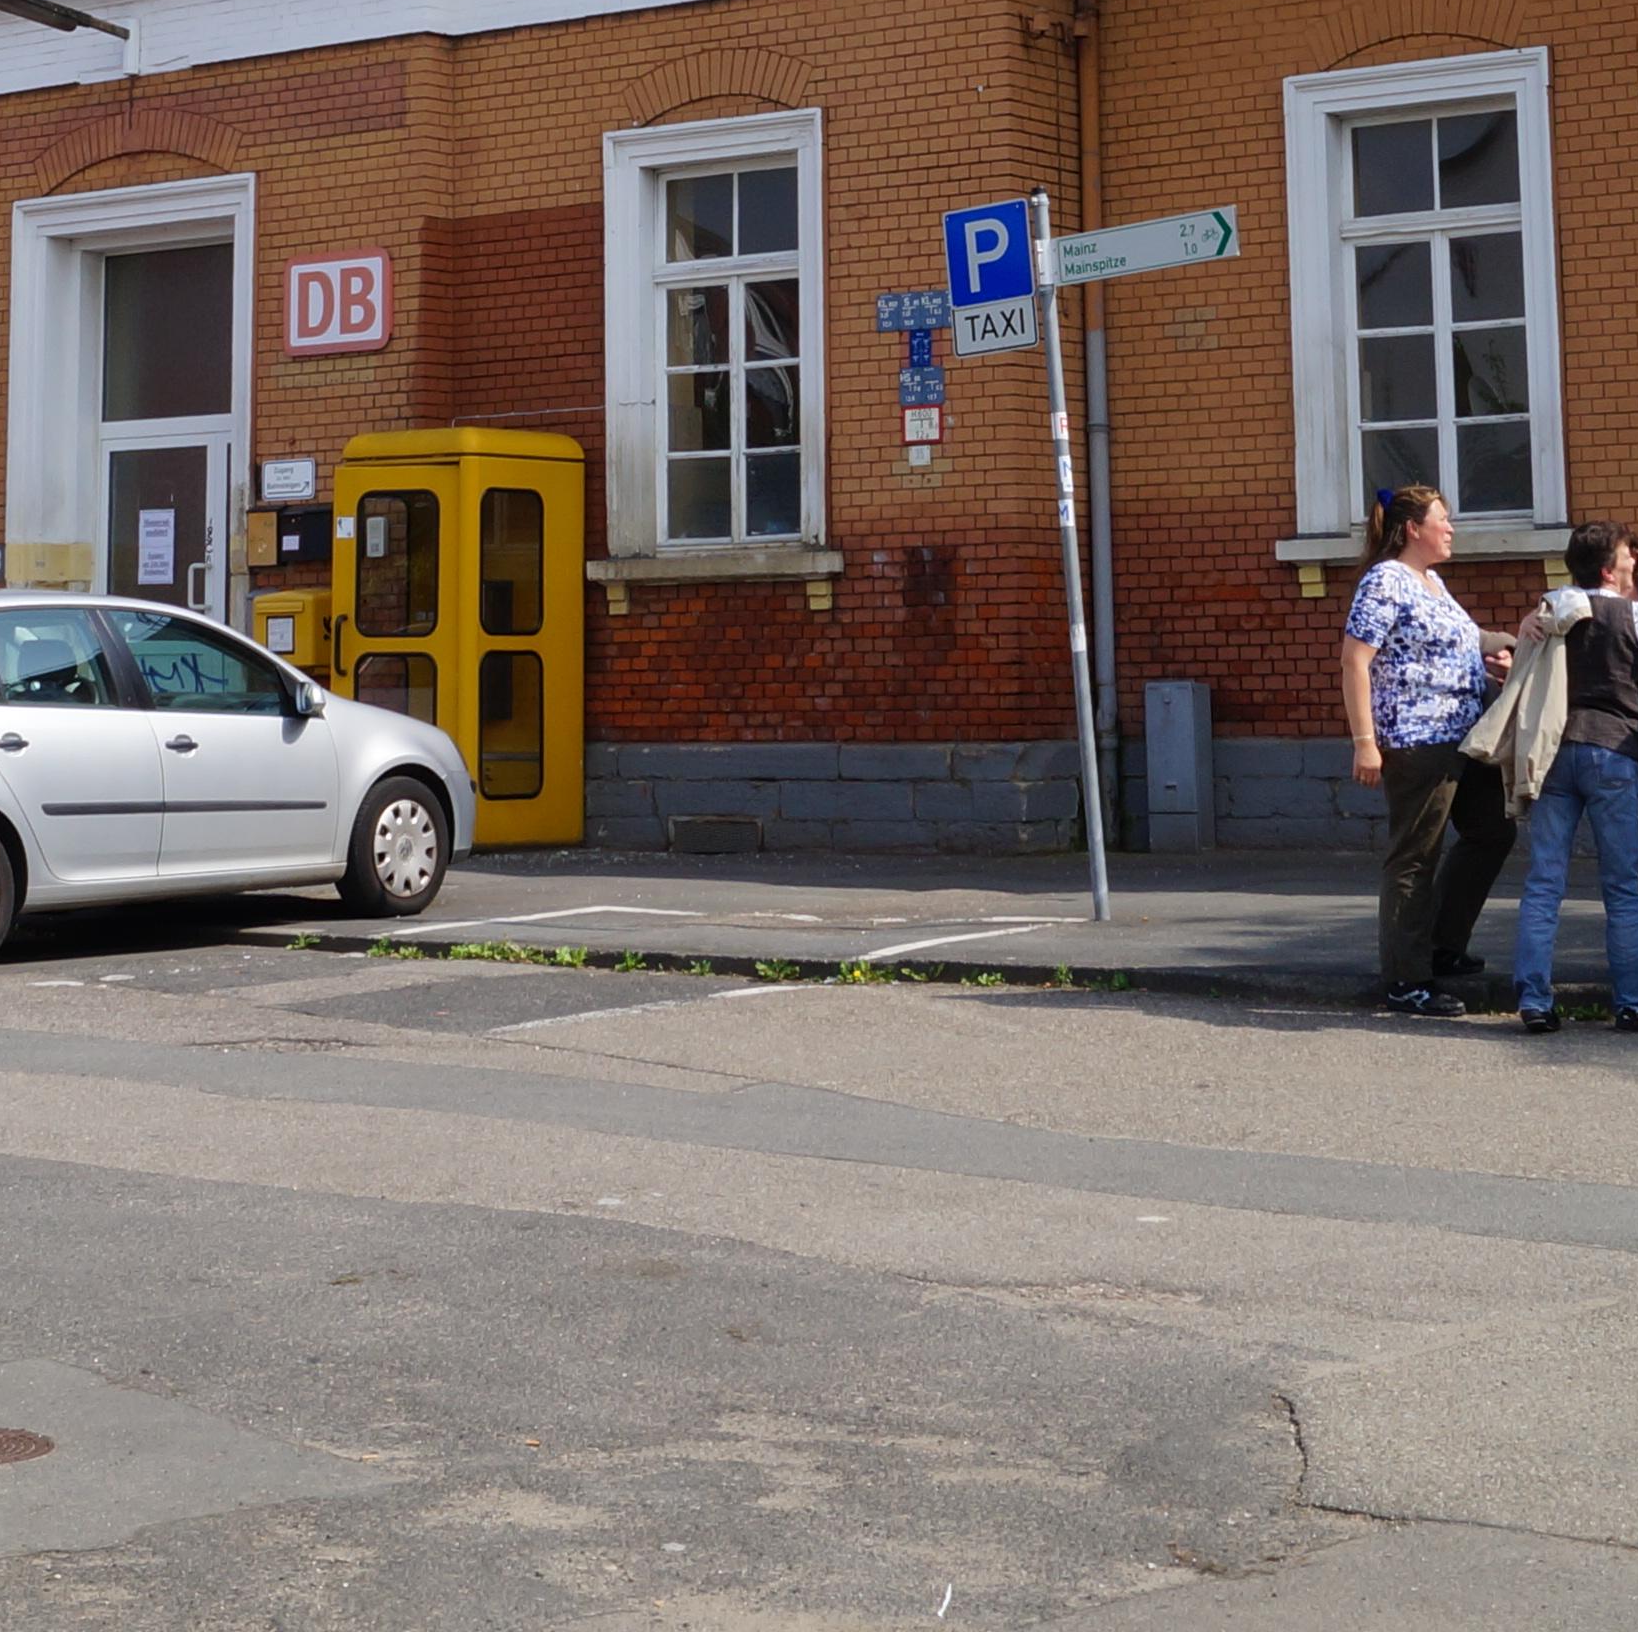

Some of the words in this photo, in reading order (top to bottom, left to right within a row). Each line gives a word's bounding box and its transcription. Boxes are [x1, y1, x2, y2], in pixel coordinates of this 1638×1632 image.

[965, 218, 1009, 294] P
[1063, 242, 1097, 257] Mainz
[1180, 224, 1195, 237] 2.7
[1064, 256, 1127, 276] Mainspitze
[1184, 242, 1198, 256] 1.0
[297, 266, 376, 339] DB
[965, 308, 1026, 343] TAXI
